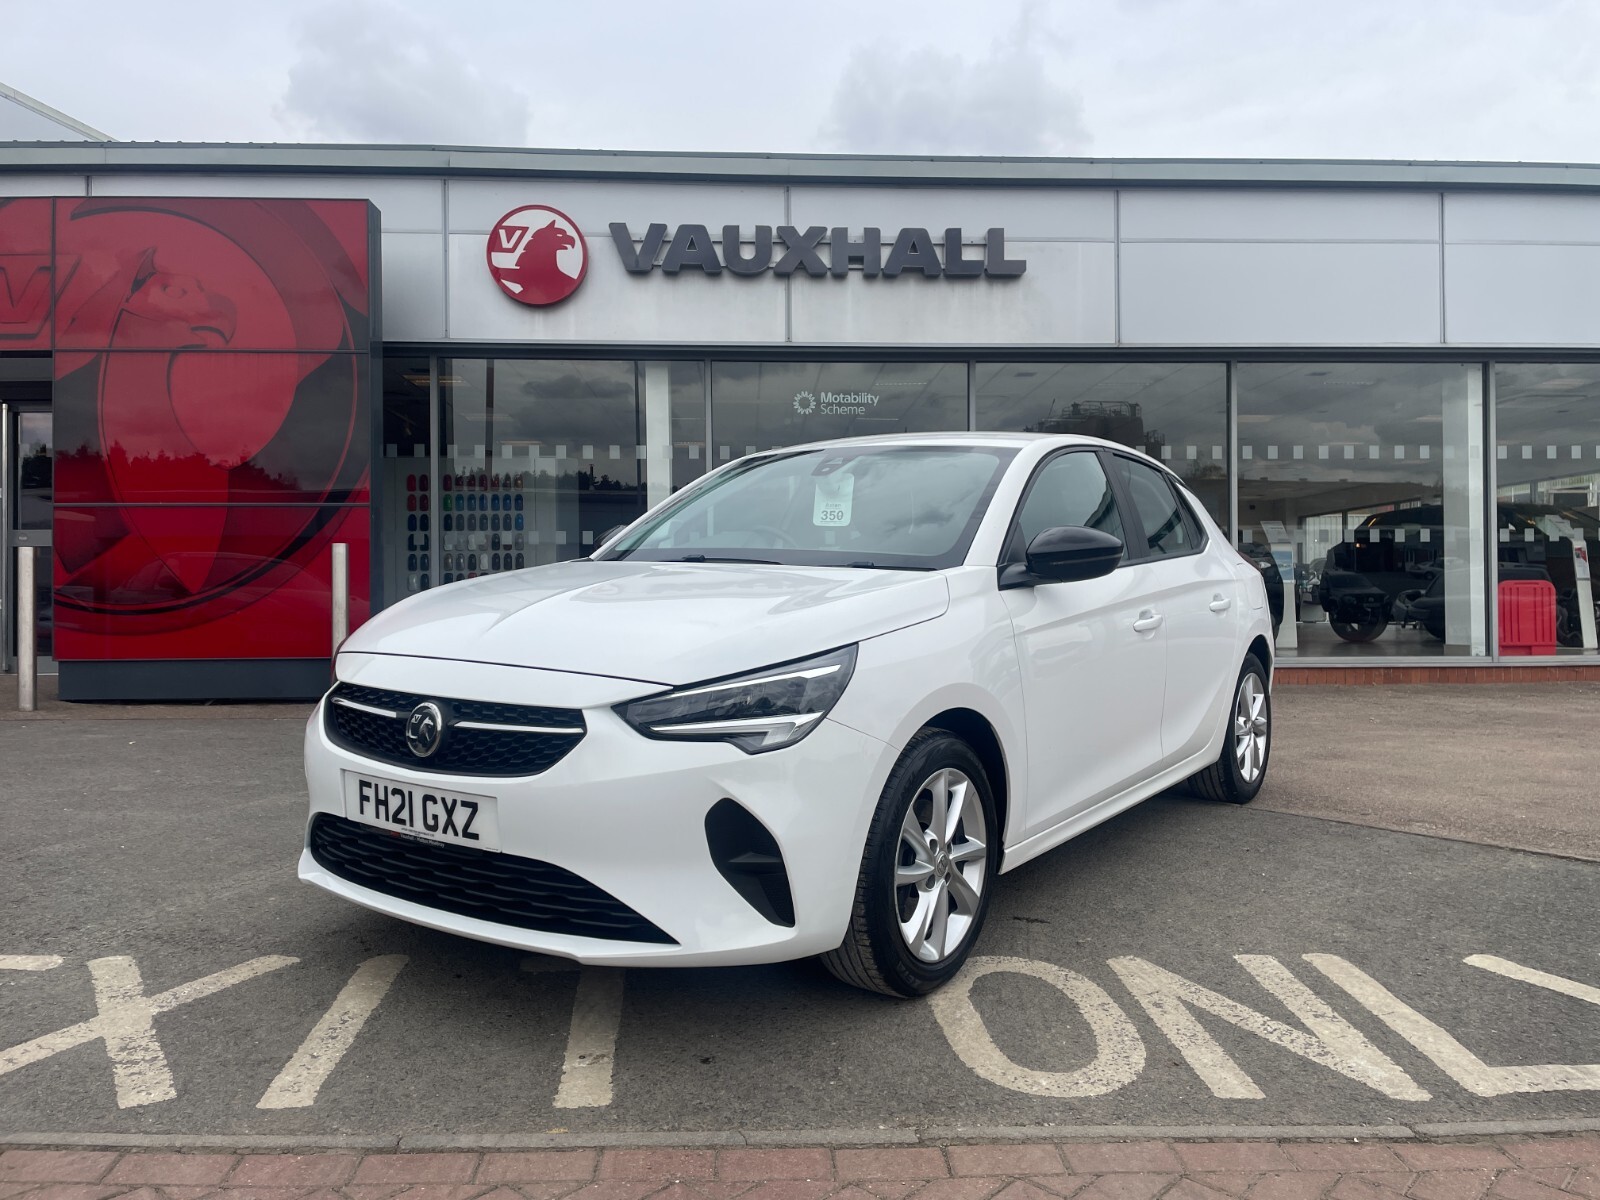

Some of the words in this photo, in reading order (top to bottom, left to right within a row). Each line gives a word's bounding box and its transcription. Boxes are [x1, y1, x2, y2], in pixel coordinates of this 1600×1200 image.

[608, 222, 1027, 278] VAUXHALL
[820, 391, 880, 407] Motability
[820, 403, 866, 415] Scheme
[820, 510, 844, 521] 350
[358, 779, 414, 828] FH21
[421, 793, 480, 841] GXZ
